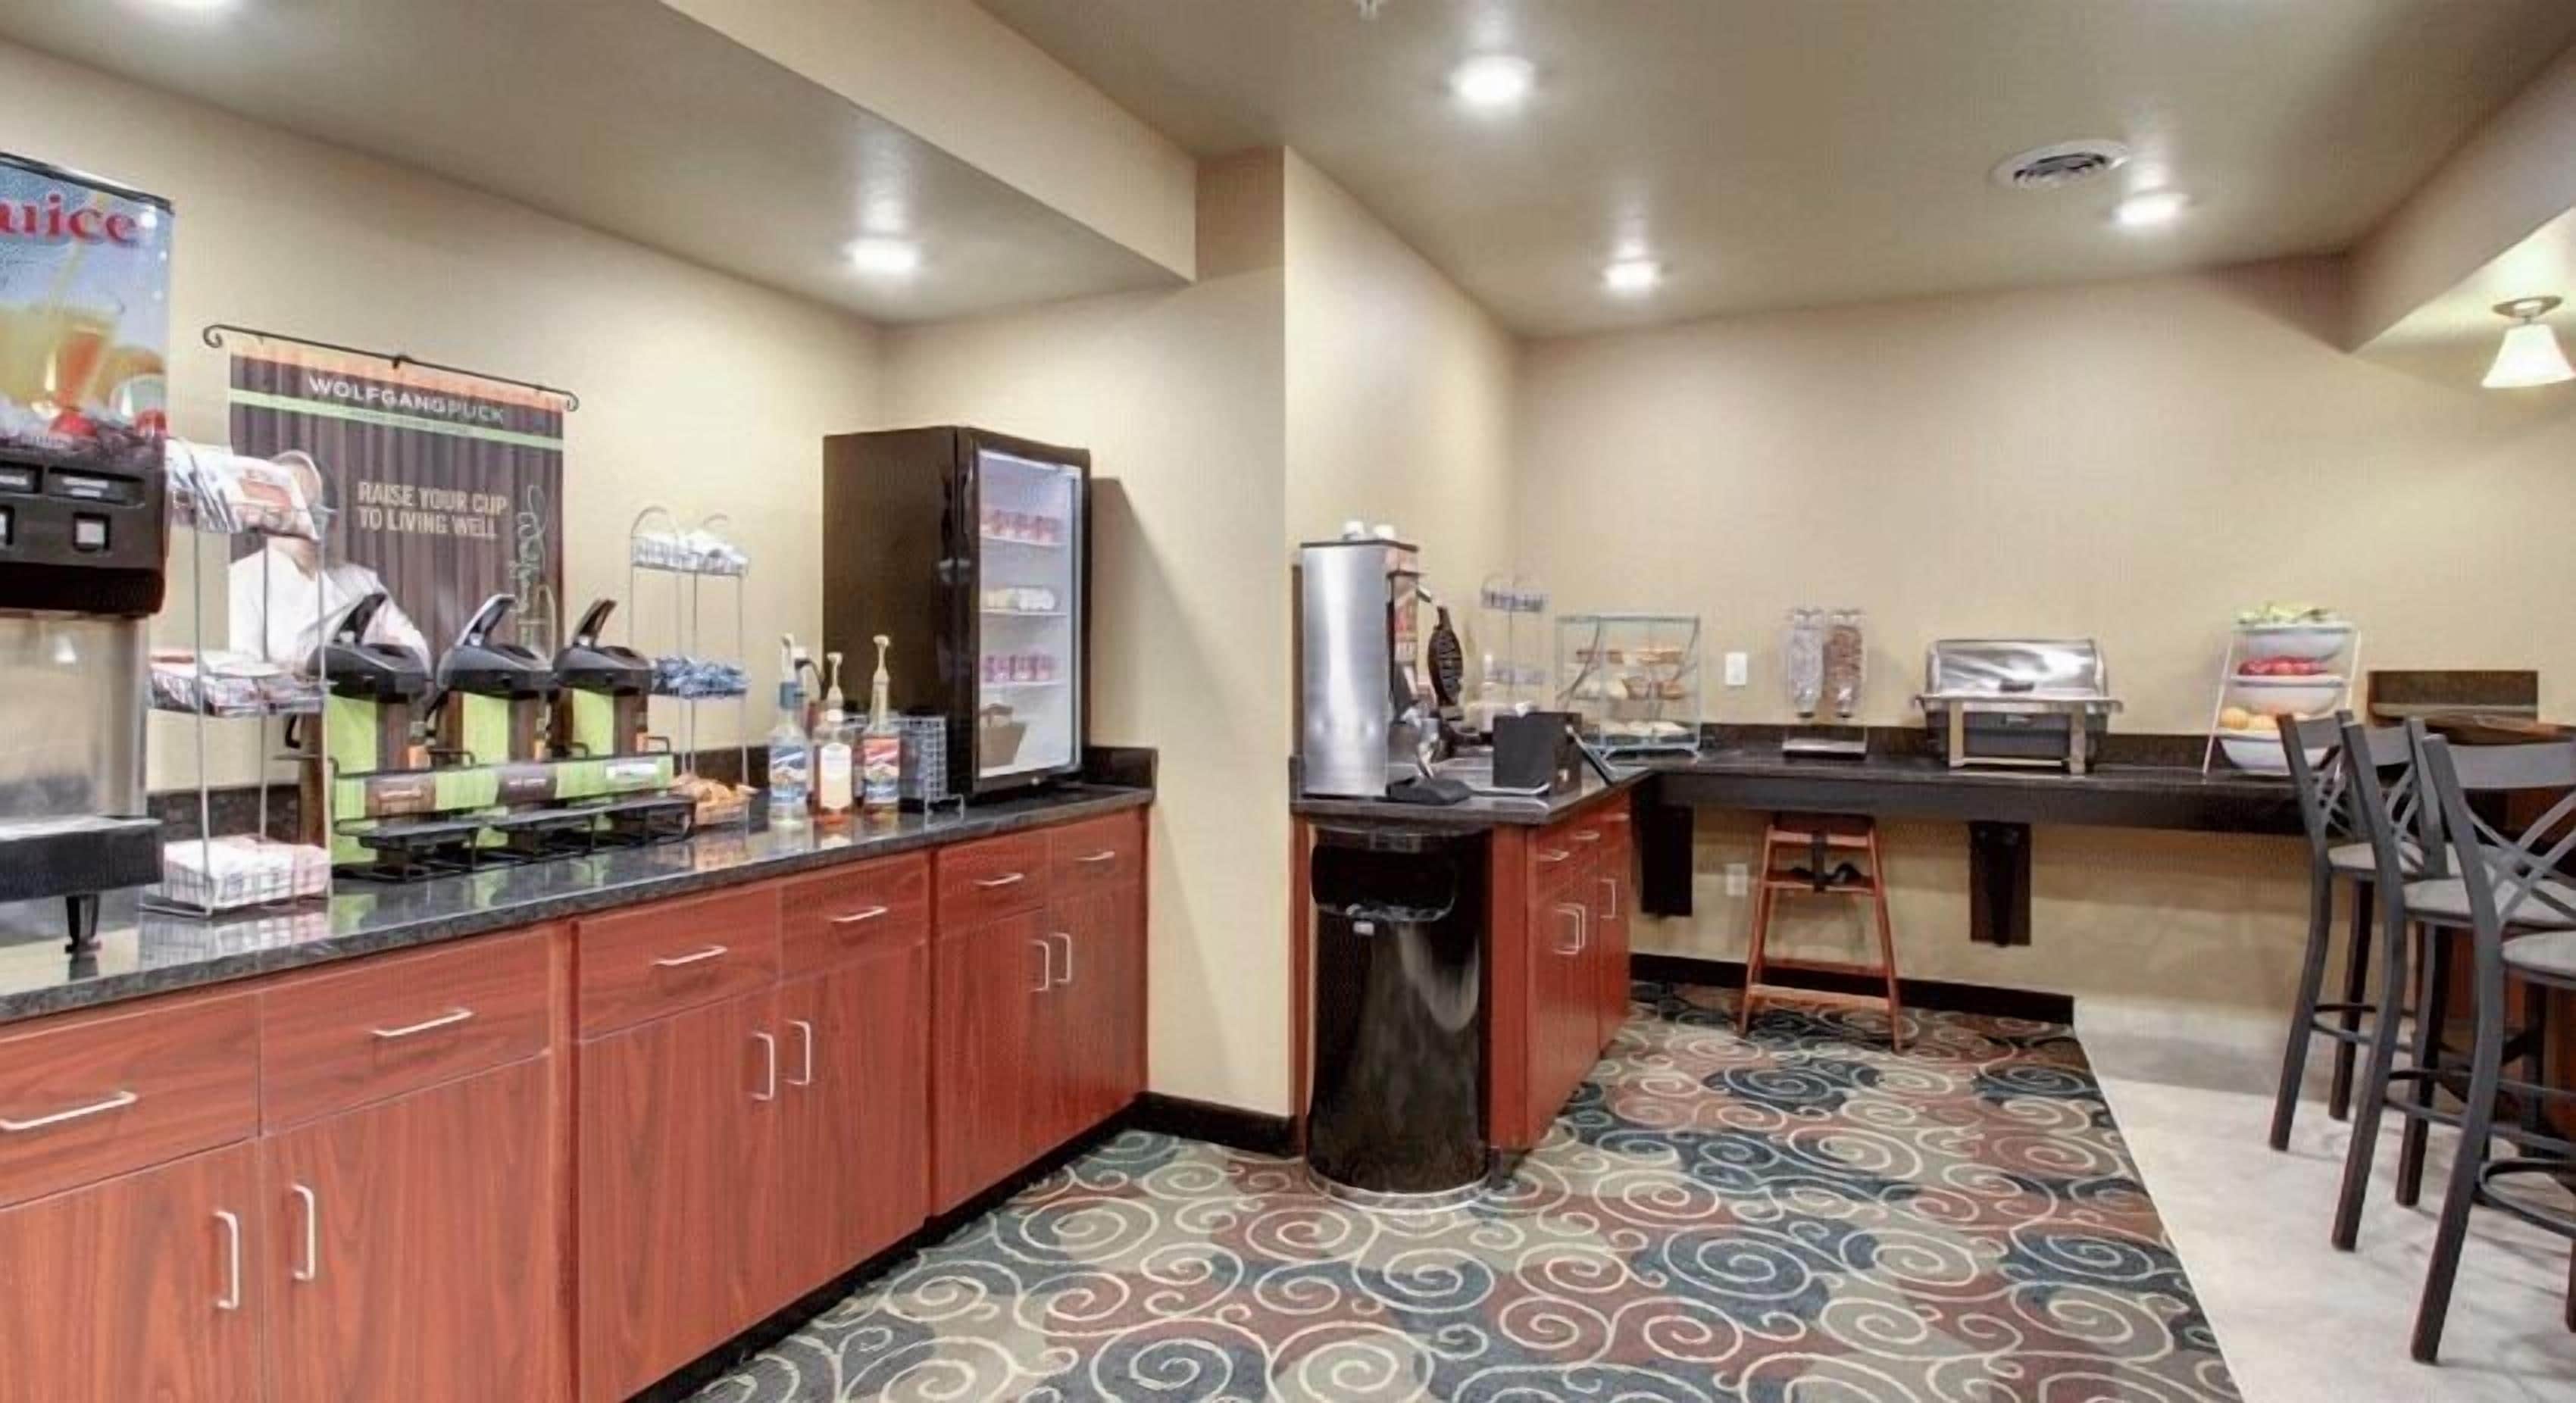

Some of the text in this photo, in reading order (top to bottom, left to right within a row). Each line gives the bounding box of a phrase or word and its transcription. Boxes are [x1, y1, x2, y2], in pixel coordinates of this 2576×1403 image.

[358, 480, 507, 516] RAISE YOUR CUP
[358, 506, 497, 539] TO LIVING WELL
